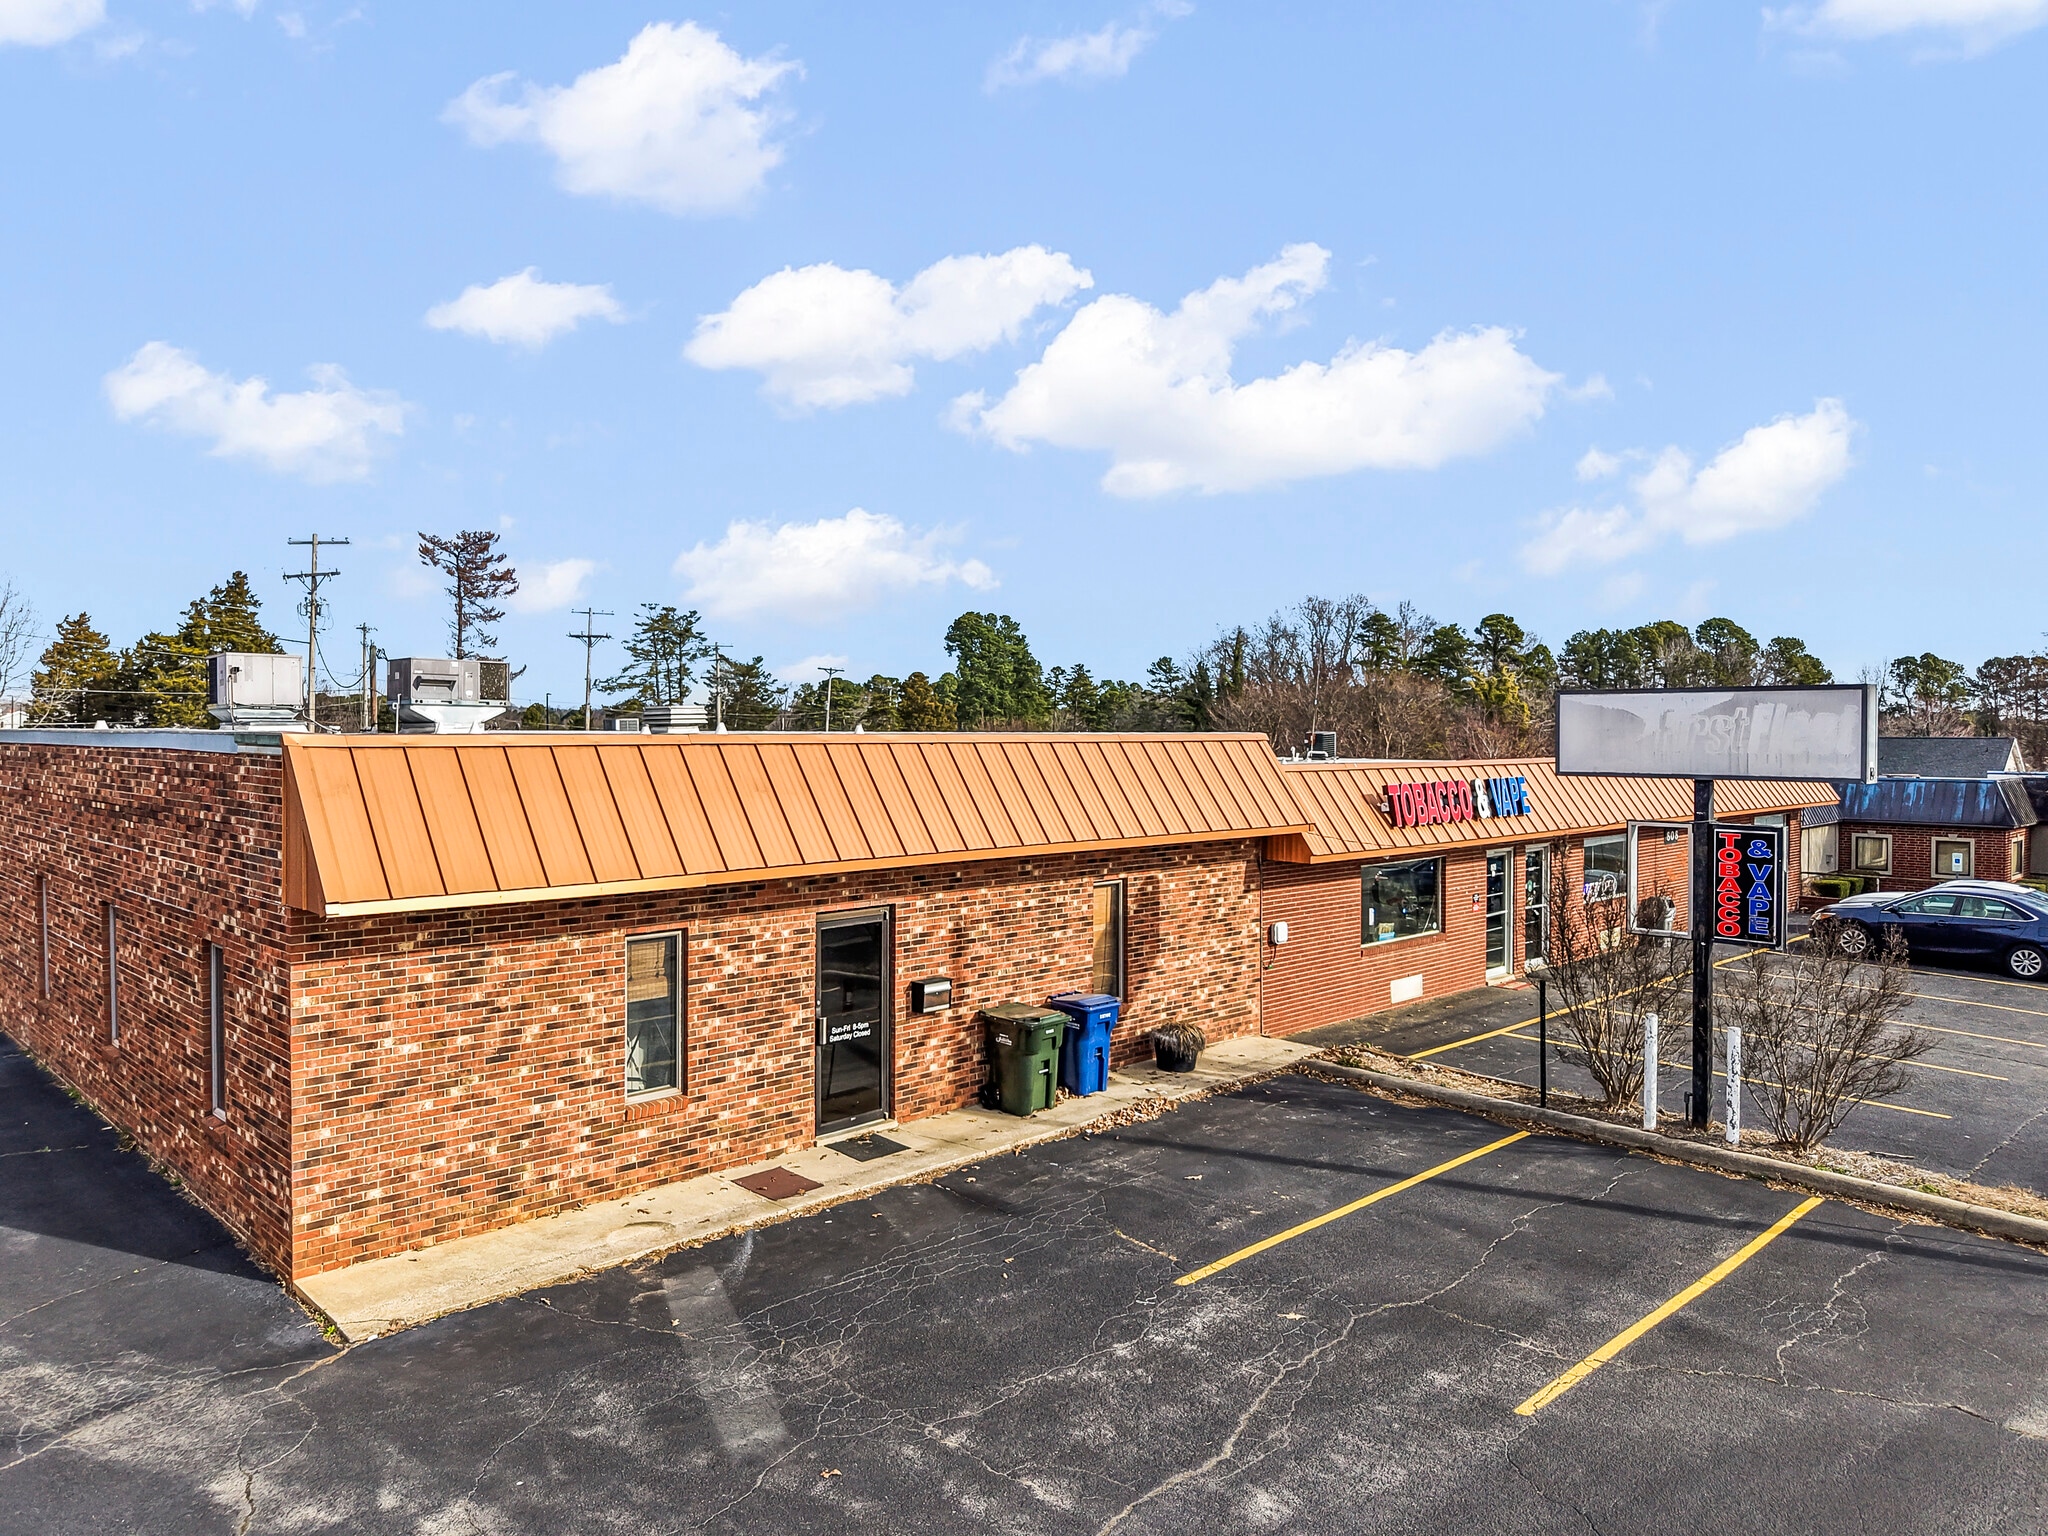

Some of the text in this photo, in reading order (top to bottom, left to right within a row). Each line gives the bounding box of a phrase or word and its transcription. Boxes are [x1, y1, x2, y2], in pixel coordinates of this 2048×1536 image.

[1387, 776, 1531, 828] TOBACCO & VAPE
[1717, 833, 1742, 937] TOBACCO
[1746, 839, 1773, 936] & VAPE
[829, 1028, 871, 1043] Saturday Closed
